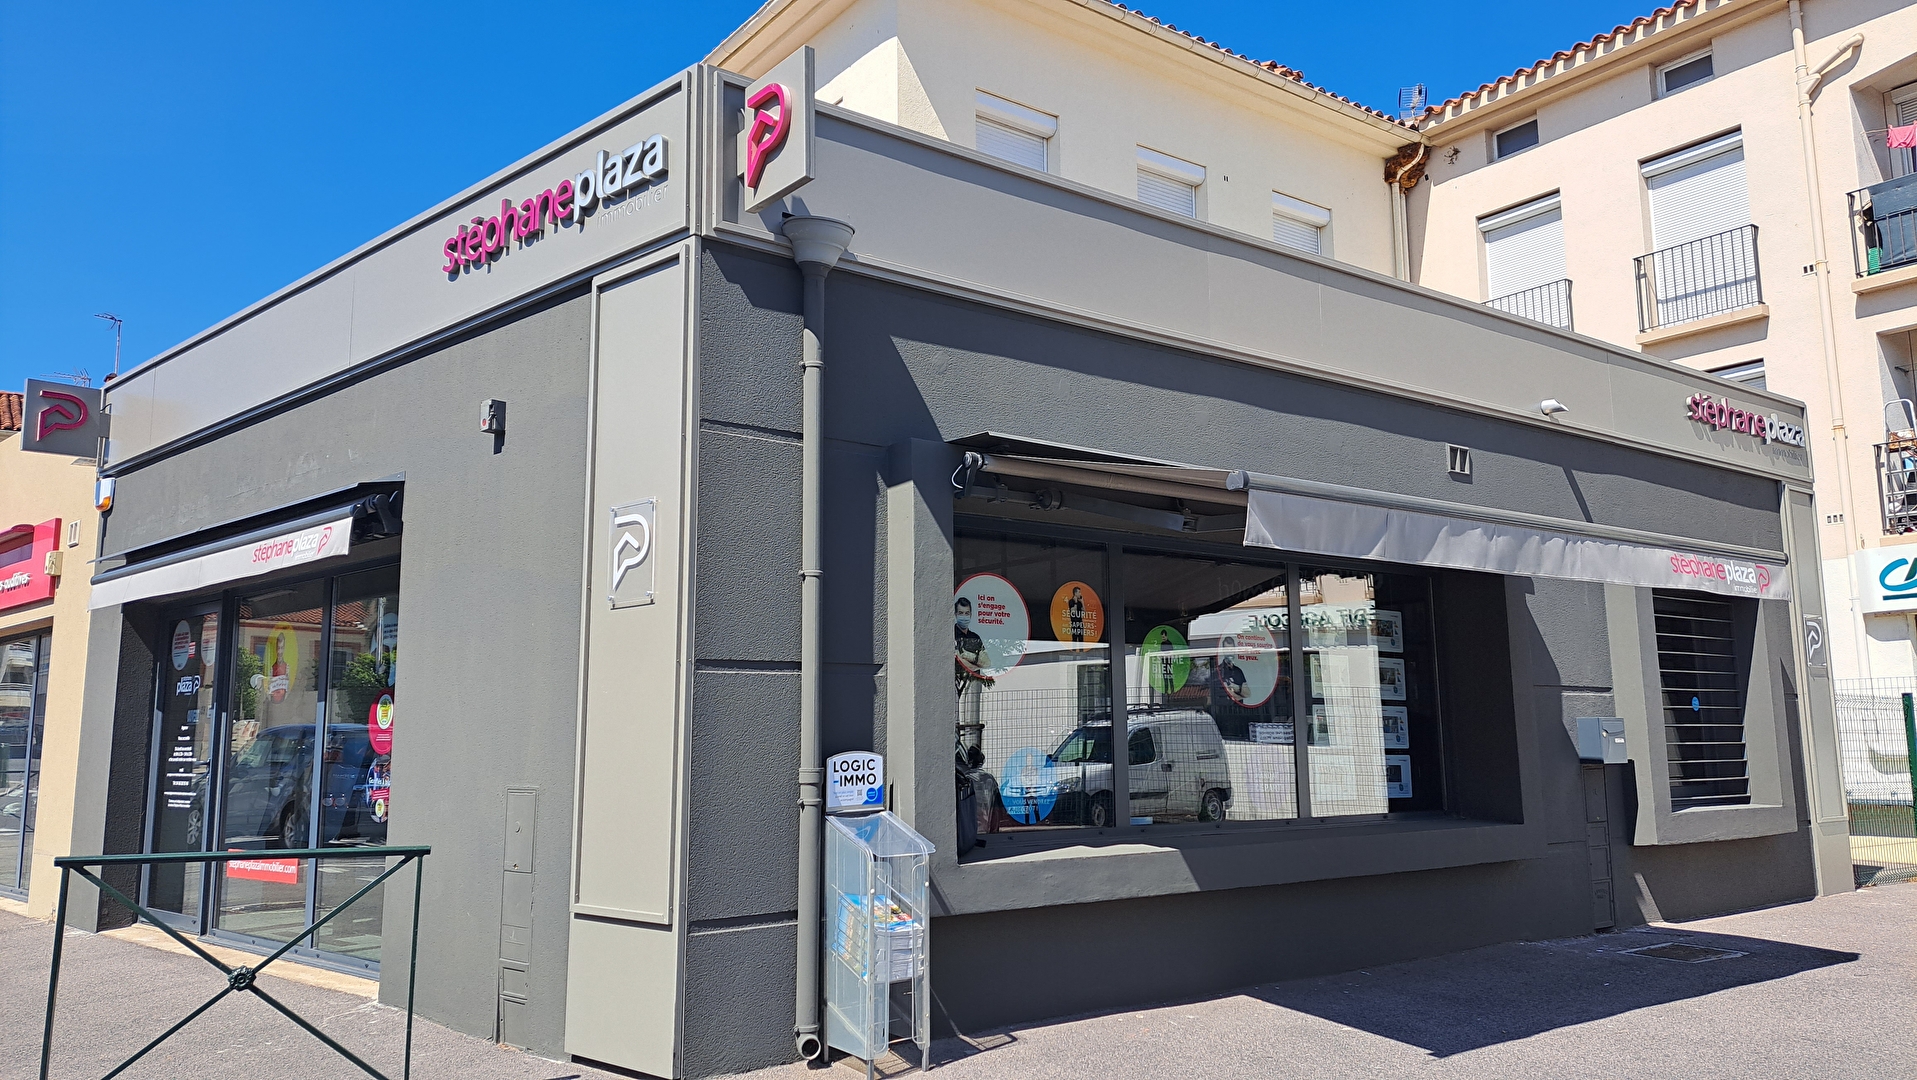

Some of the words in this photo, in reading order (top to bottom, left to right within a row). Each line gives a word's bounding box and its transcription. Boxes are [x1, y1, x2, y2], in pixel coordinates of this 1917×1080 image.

[597, 184, 669, 228] immobilier
[978, 602, 1005, 611] s'engage
[978, 611, 993, 619] pour
[1062, 608, 1097, 619] SÉCURITÉ
[978, 618, 1005, 626] sécurité.
[833, 759, 876, 773] LOGIC
